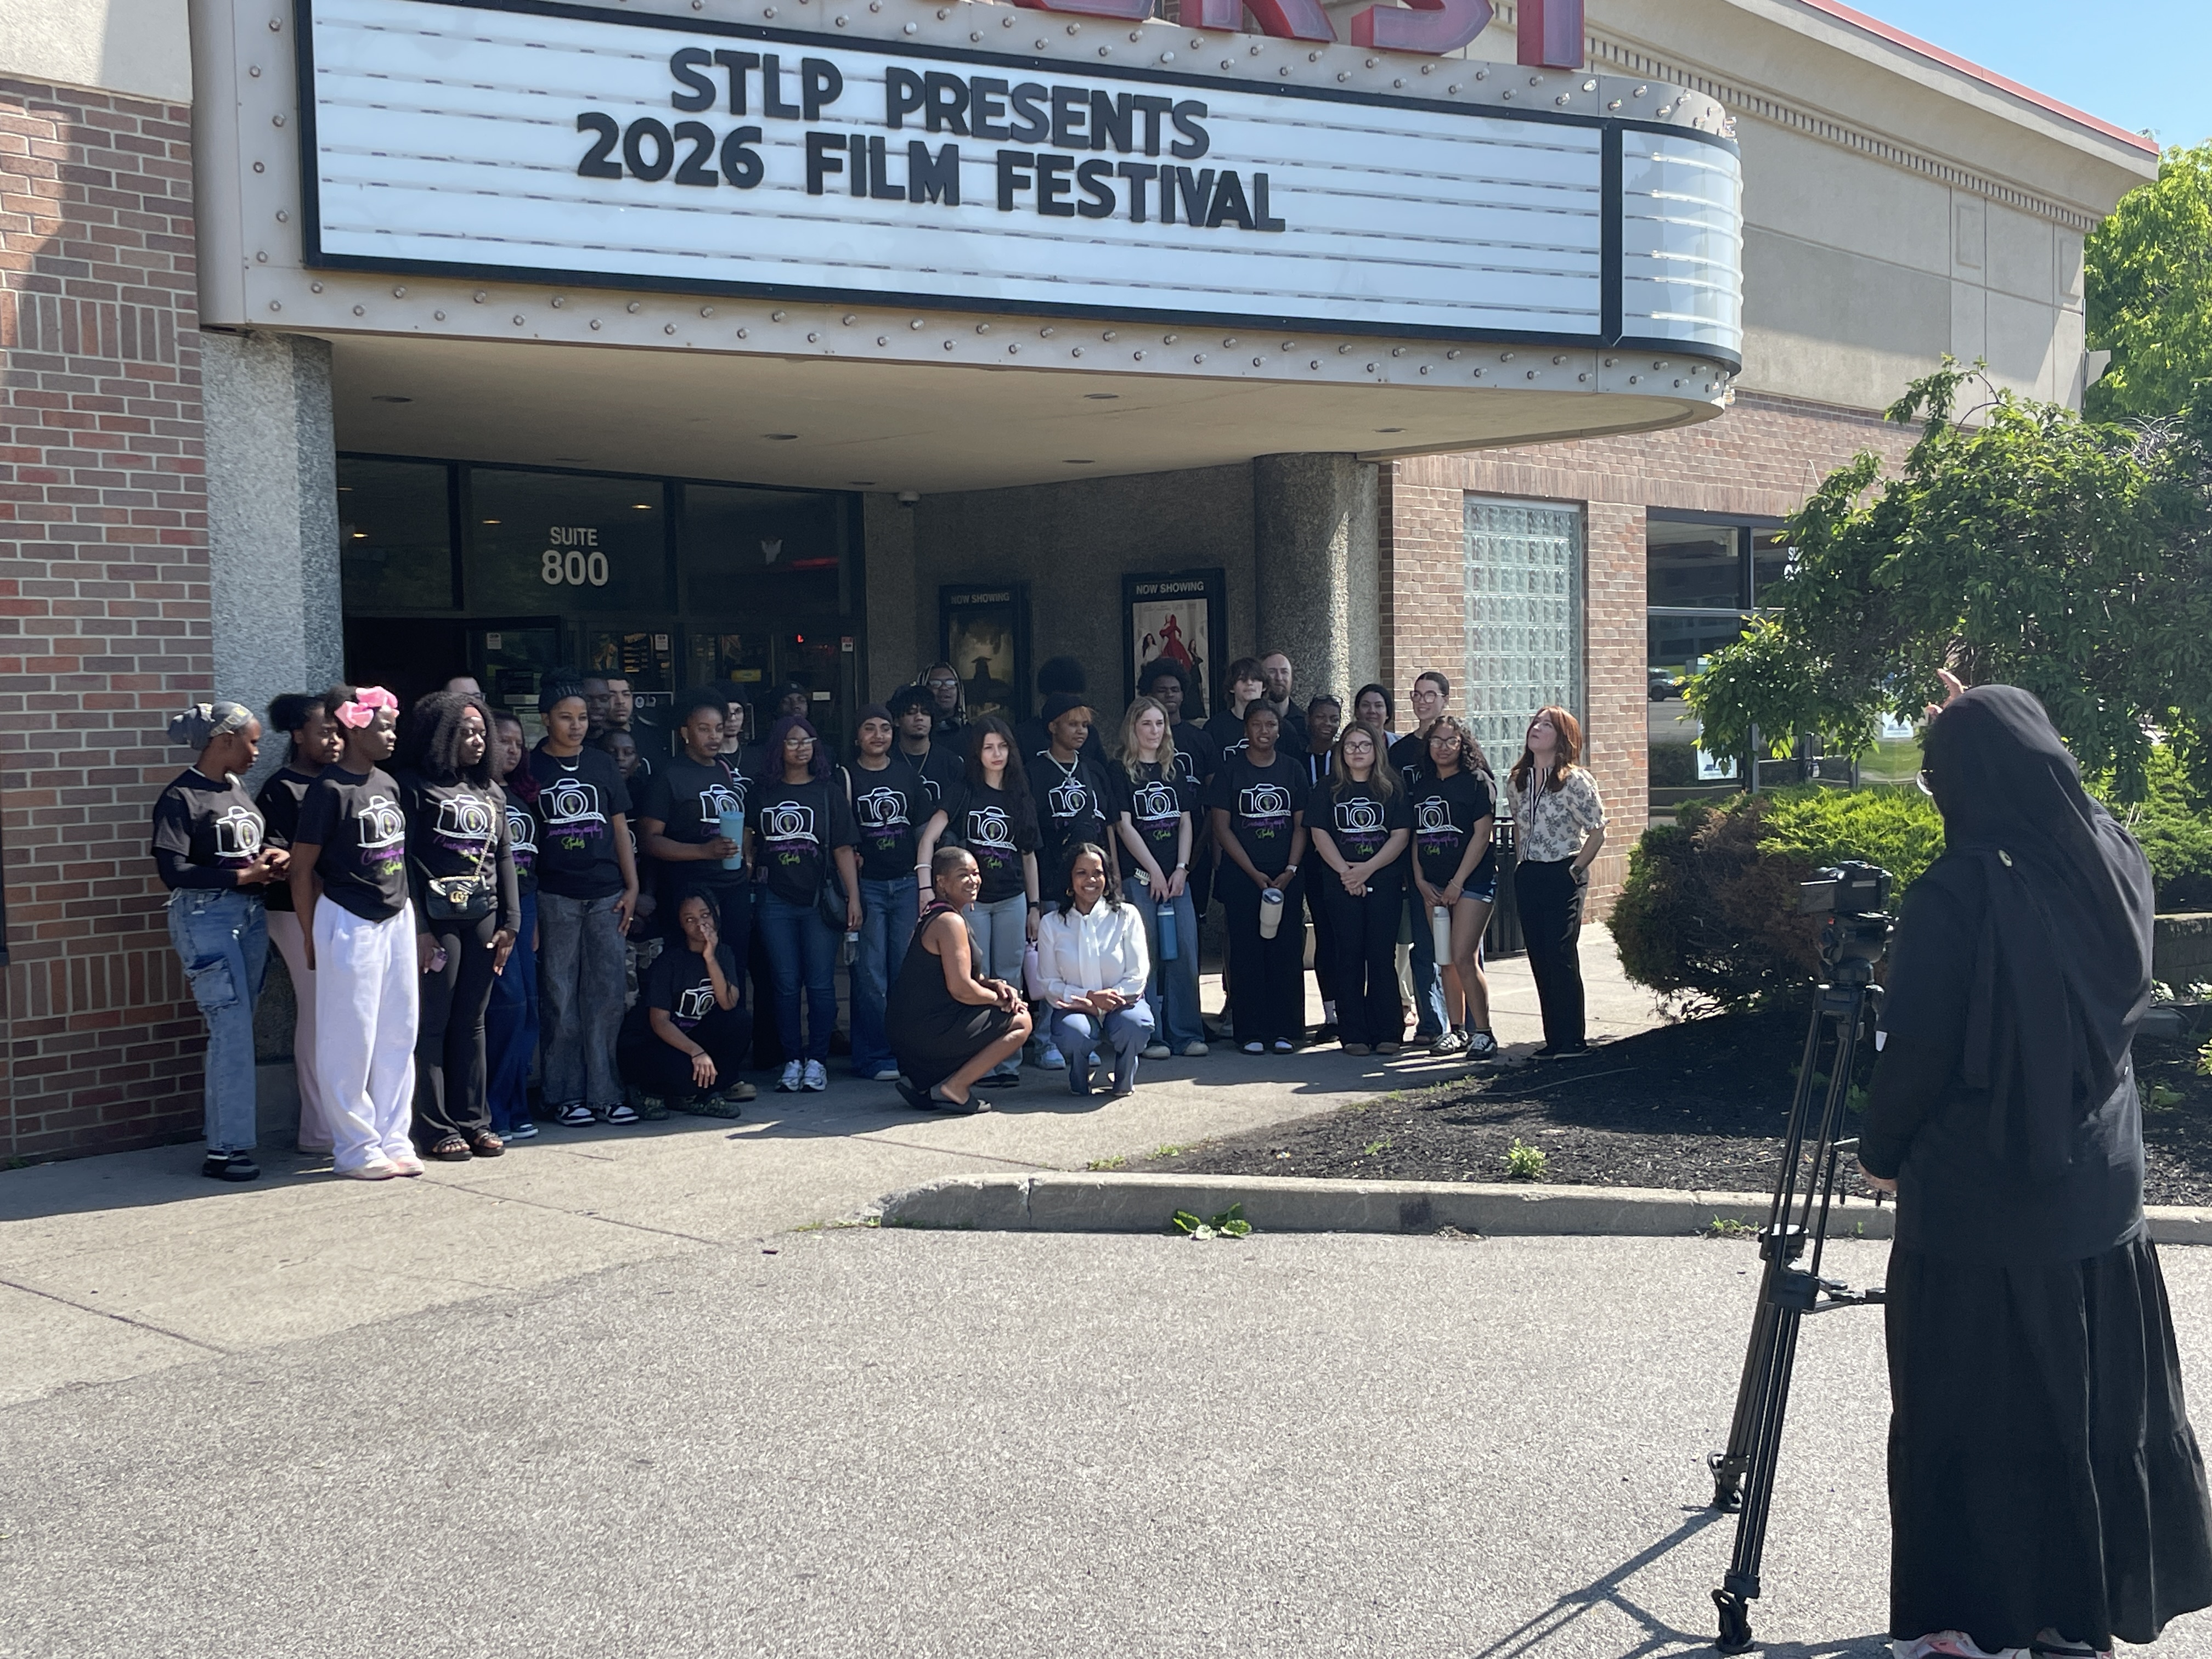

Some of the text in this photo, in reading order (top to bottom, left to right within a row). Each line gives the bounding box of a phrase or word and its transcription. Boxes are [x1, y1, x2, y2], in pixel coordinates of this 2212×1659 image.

[670, 48, 1210, 159] STLP PRESENTS
[577, 112, 1285, 232] 2026 FILM FESTIVAL
[550, 526, 598, 546] SUITE
[542, 550, 609, 586] 800
[951, 592, 1009, 604] NOW SHOWING
[1136, 581, 1204, 595] NOW SHOWING
